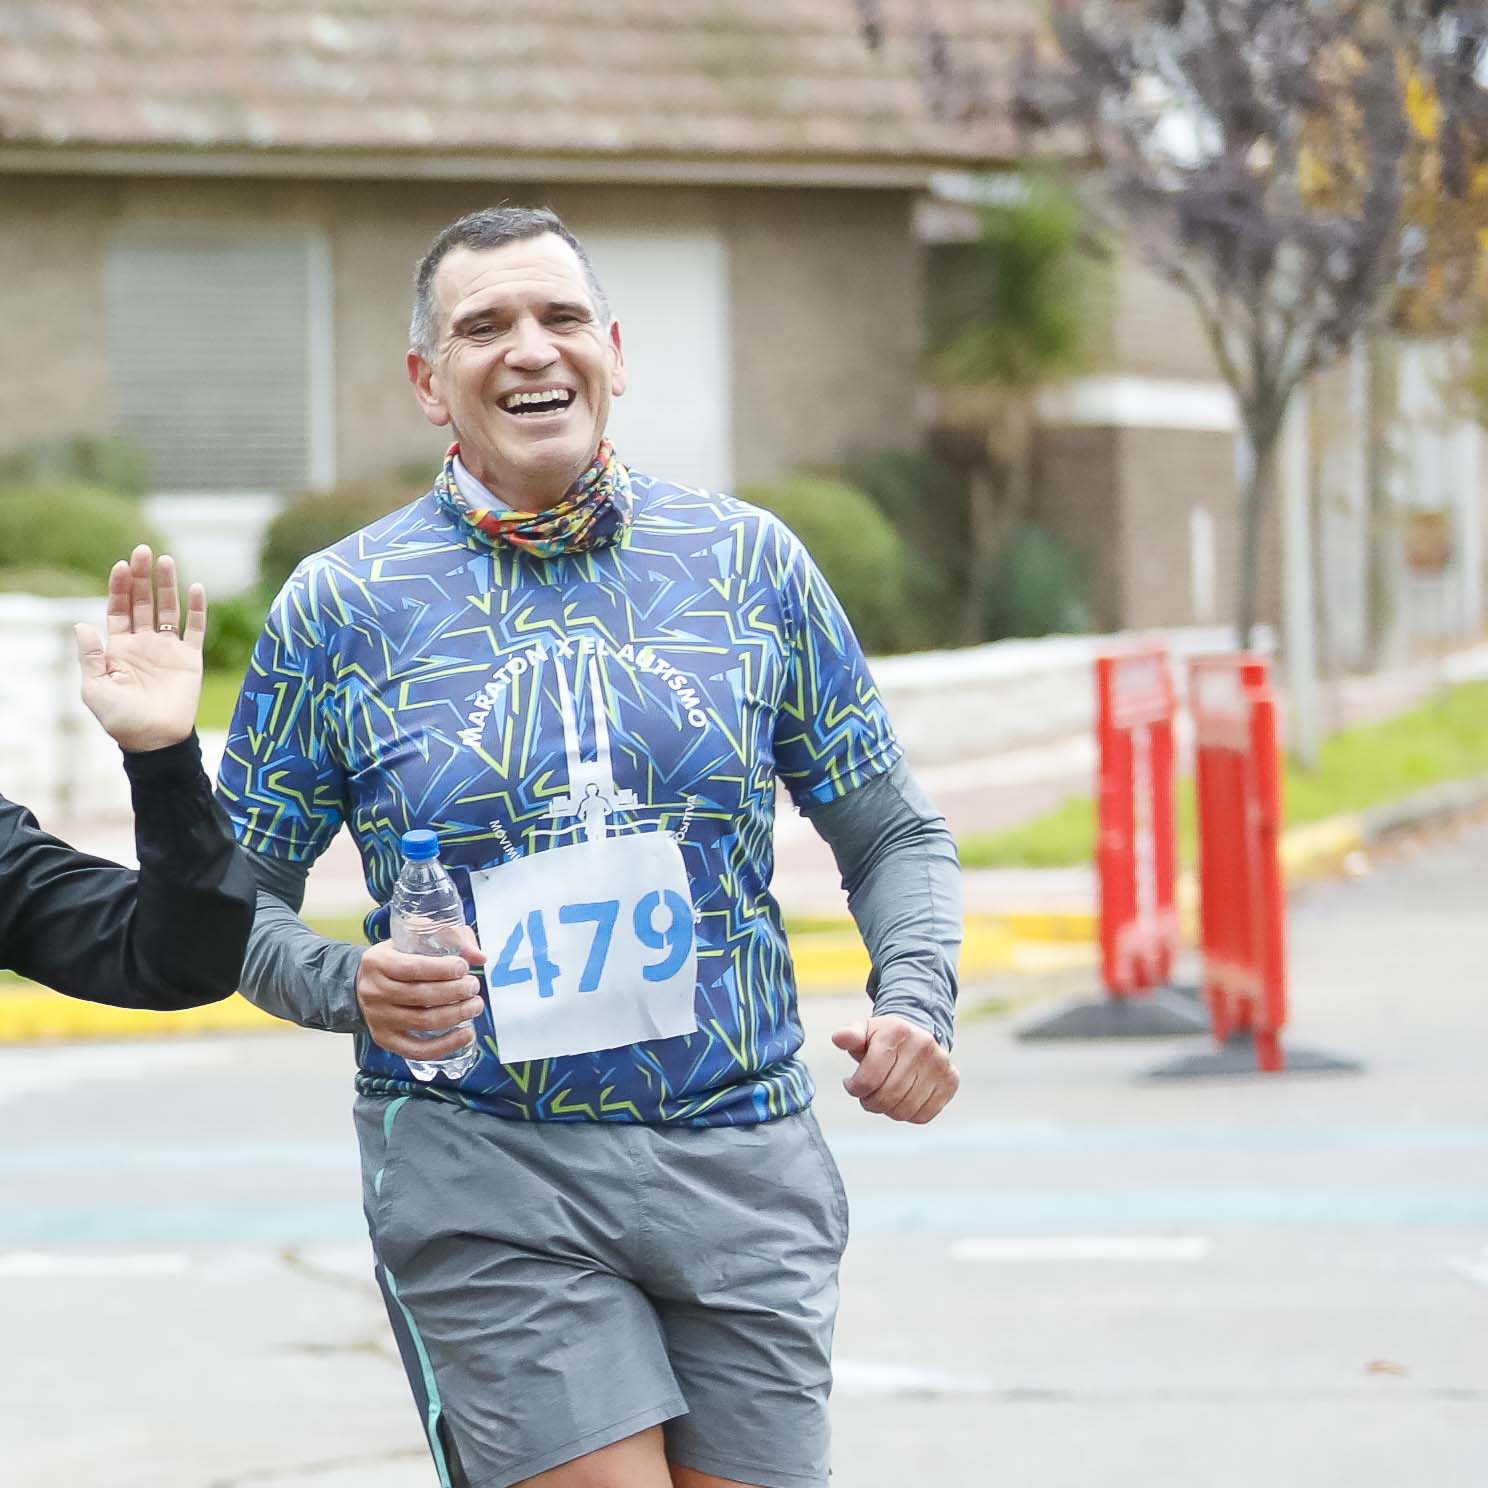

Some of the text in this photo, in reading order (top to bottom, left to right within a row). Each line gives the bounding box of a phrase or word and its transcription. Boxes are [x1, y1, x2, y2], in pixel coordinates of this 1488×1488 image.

[456, 636, 708, 747] MARATÓN X EL AUTISMO
[673, 794, 697, 842] OSITIVA
[491, 888, 694, 998] 479
